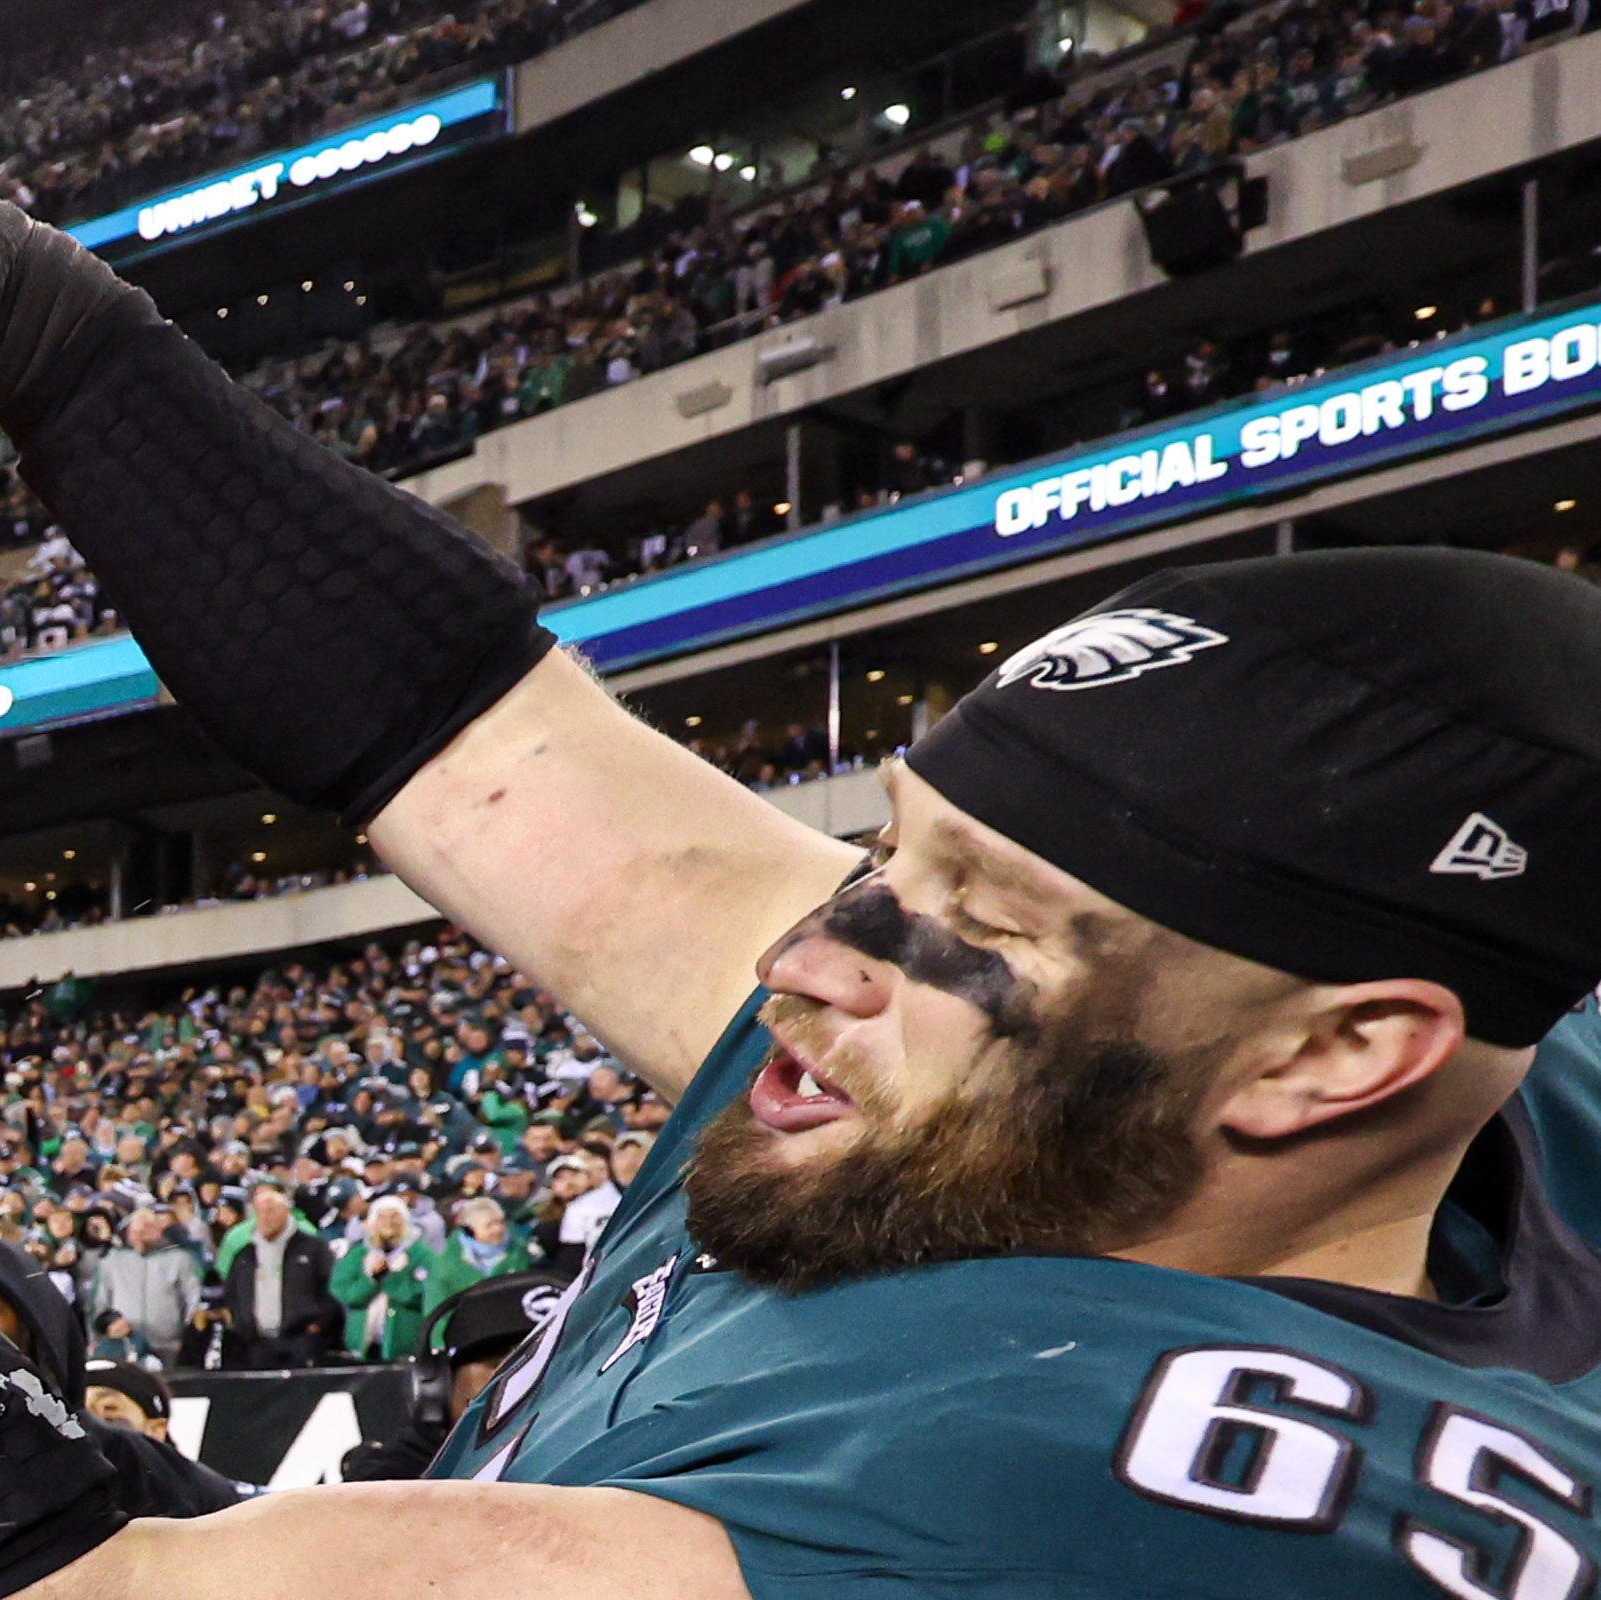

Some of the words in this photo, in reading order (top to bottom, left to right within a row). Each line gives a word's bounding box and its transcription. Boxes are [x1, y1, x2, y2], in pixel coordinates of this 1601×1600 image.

[994, 435, 1228, 538] OFFICIAL
[1239, 354, 1489, 470] SPORTS
[1503, 323, 1601, 397] BO
